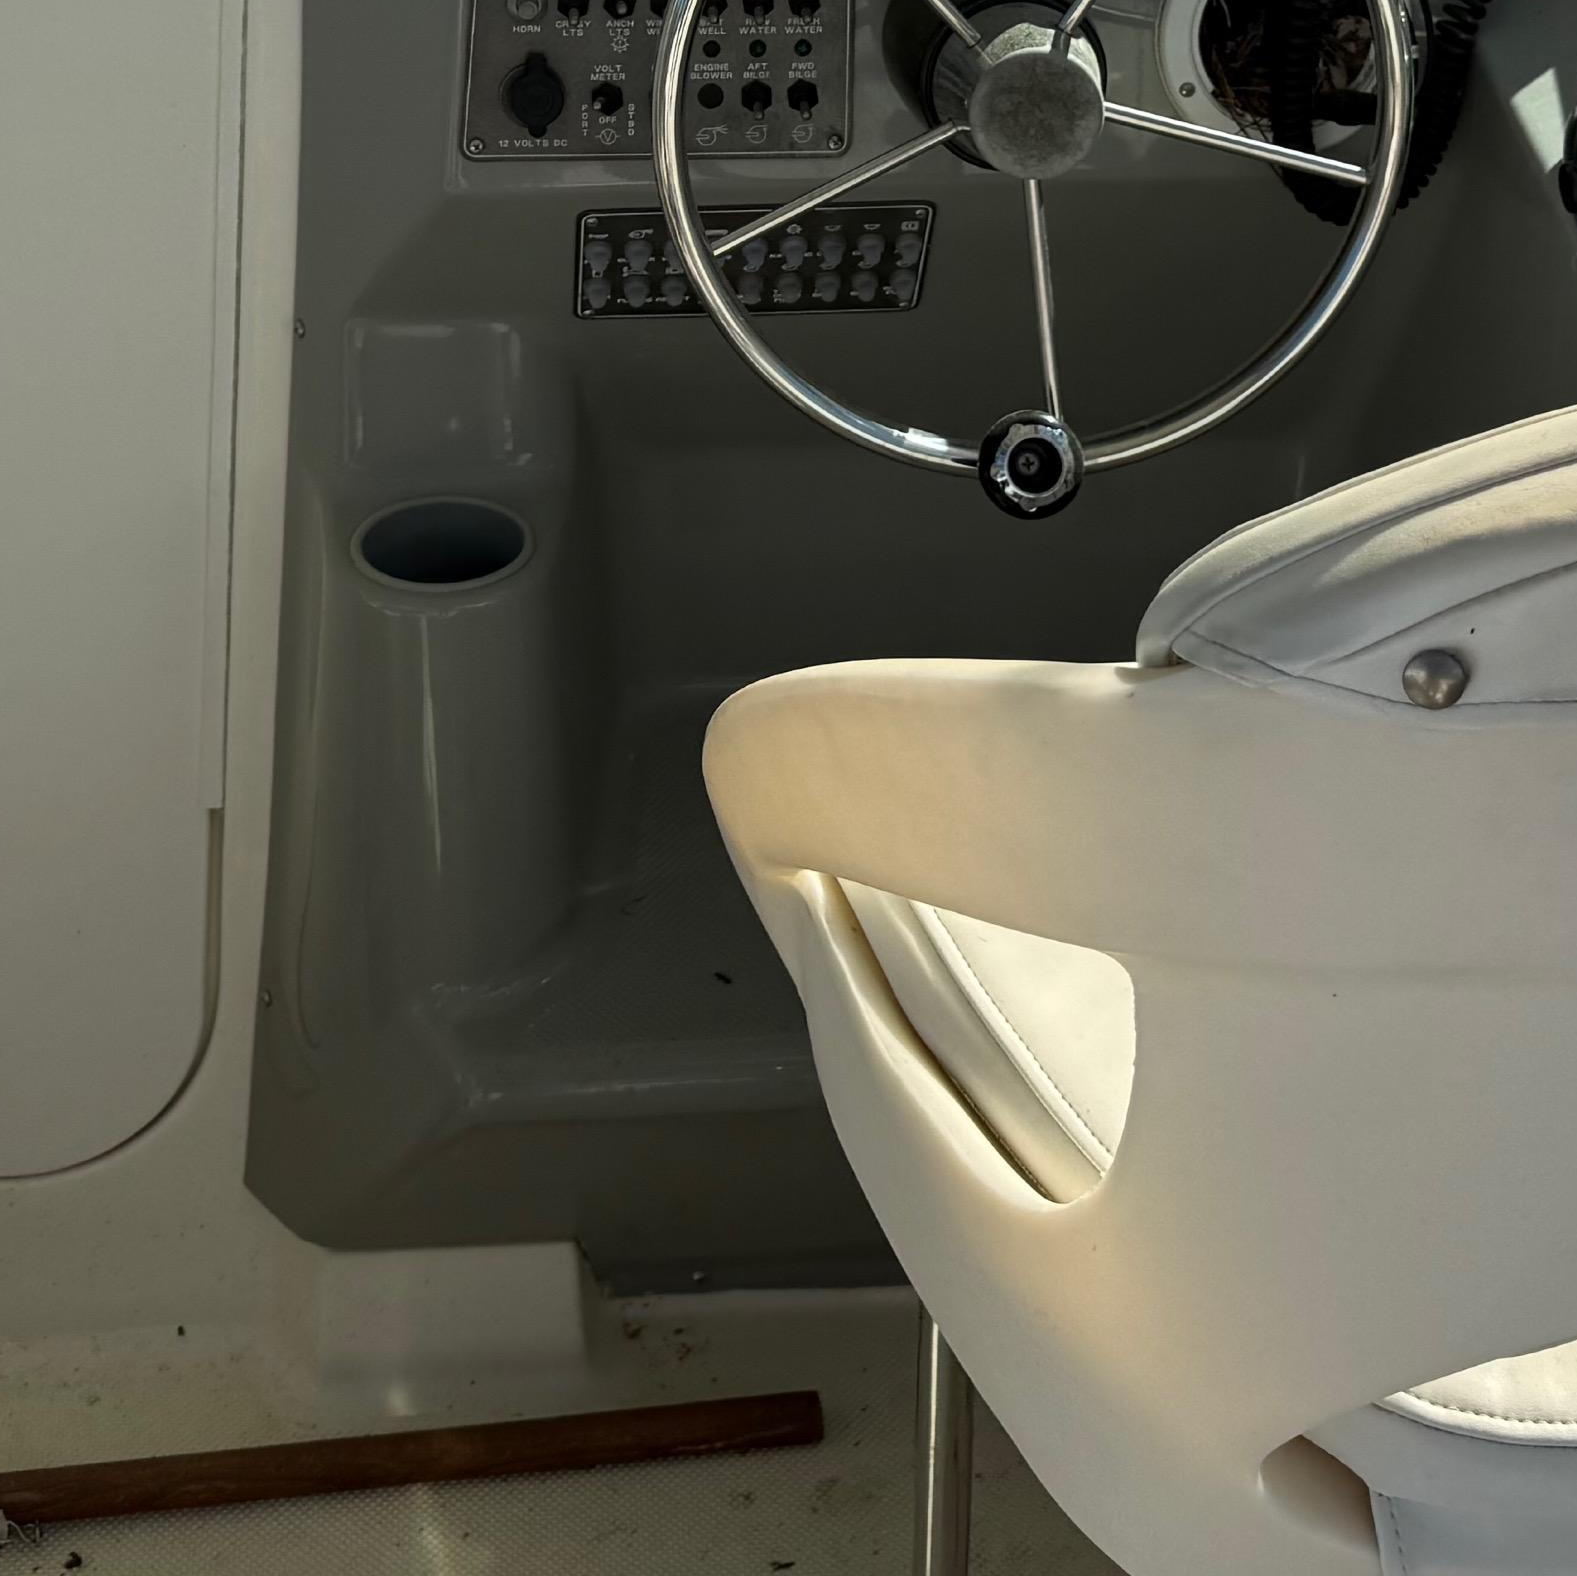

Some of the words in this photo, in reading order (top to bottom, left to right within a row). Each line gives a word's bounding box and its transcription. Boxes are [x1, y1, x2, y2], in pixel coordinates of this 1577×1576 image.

[606, 20, 634, 28] ANCH
[698, 27, 727, 35] WELL
[739, 27, 777, 35] WATER
[784, 26, 822, 34] WATER
[594, 65, 622, 73] VOLT
[694, 63, 729, 71] ENGINE
[747, 62, 768, 70] AFT
[791, 62, 815, 70] FWD
[590, 73, 626, 81] METER
[690, 71, 733, 80] BLOWER
[788, 71, 817, 79] BILGE
[599, 116, 616, 124] OFF
[498, 139, 509, 147] 12
[514, 139, 550, 147] VOLTS
[553, 139, 568, 147] DC
